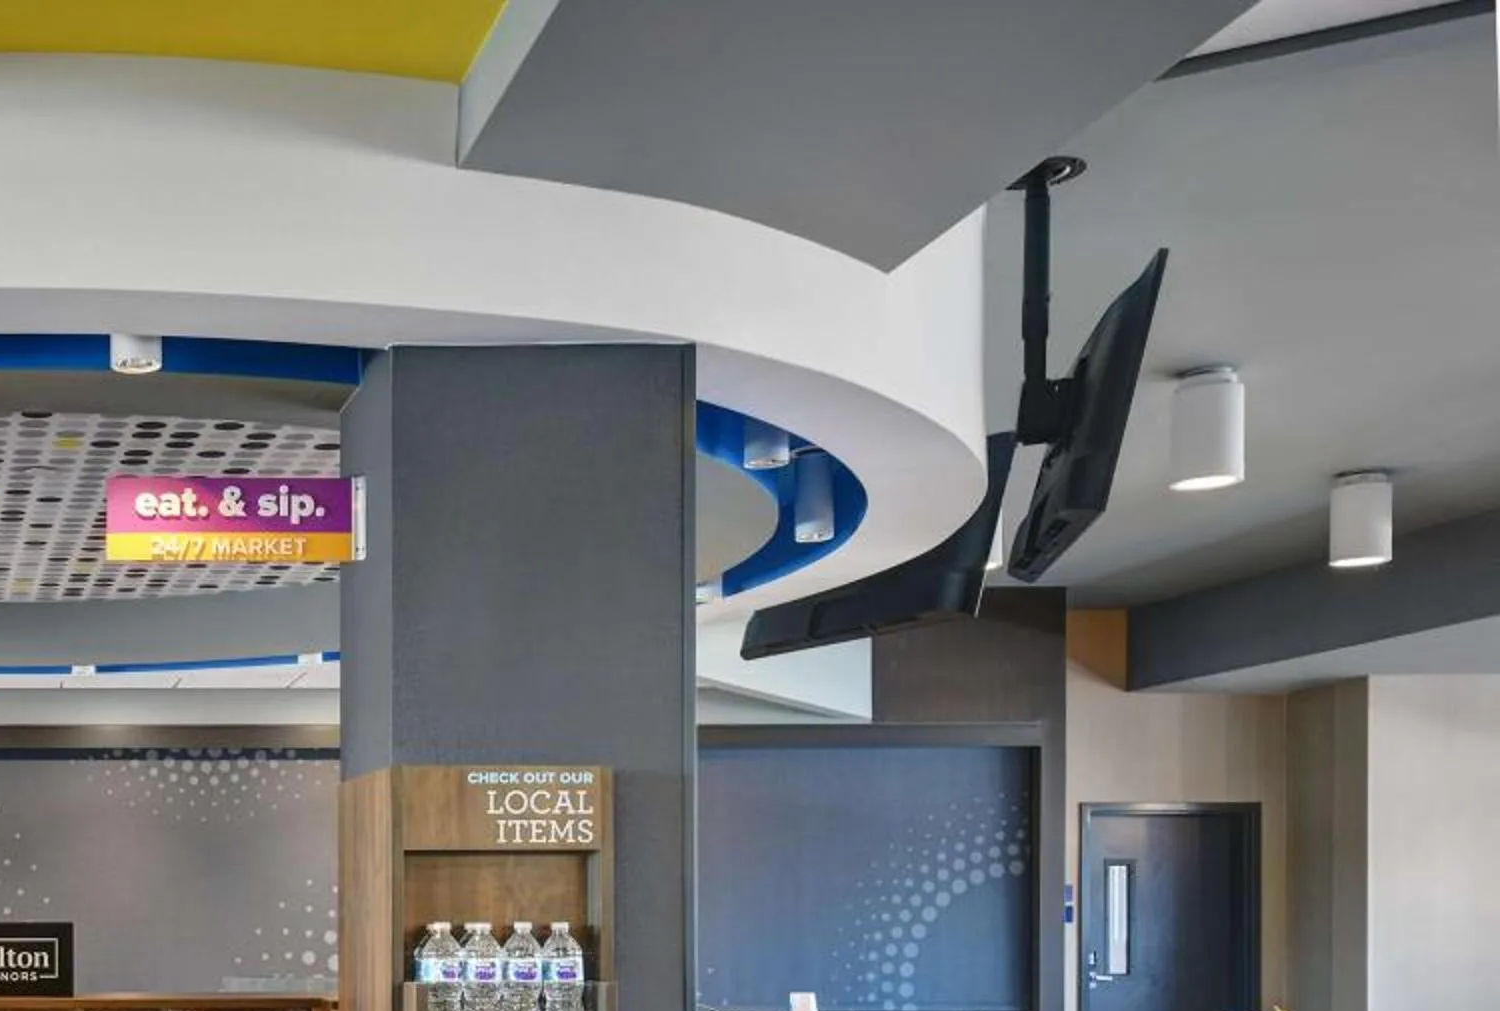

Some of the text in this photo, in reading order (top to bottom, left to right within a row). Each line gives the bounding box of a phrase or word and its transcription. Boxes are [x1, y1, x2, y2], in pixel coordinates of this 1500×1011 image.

[135, 484, 325, 525] eat. & sip.
[151, 537, 307, 558] 24/7 MARKET
[467, 771, 594, 784] CHECK OUT OUR
[486, 789, 594, 815] LOCAL
[496, 818, 594, 844] ITEMS
